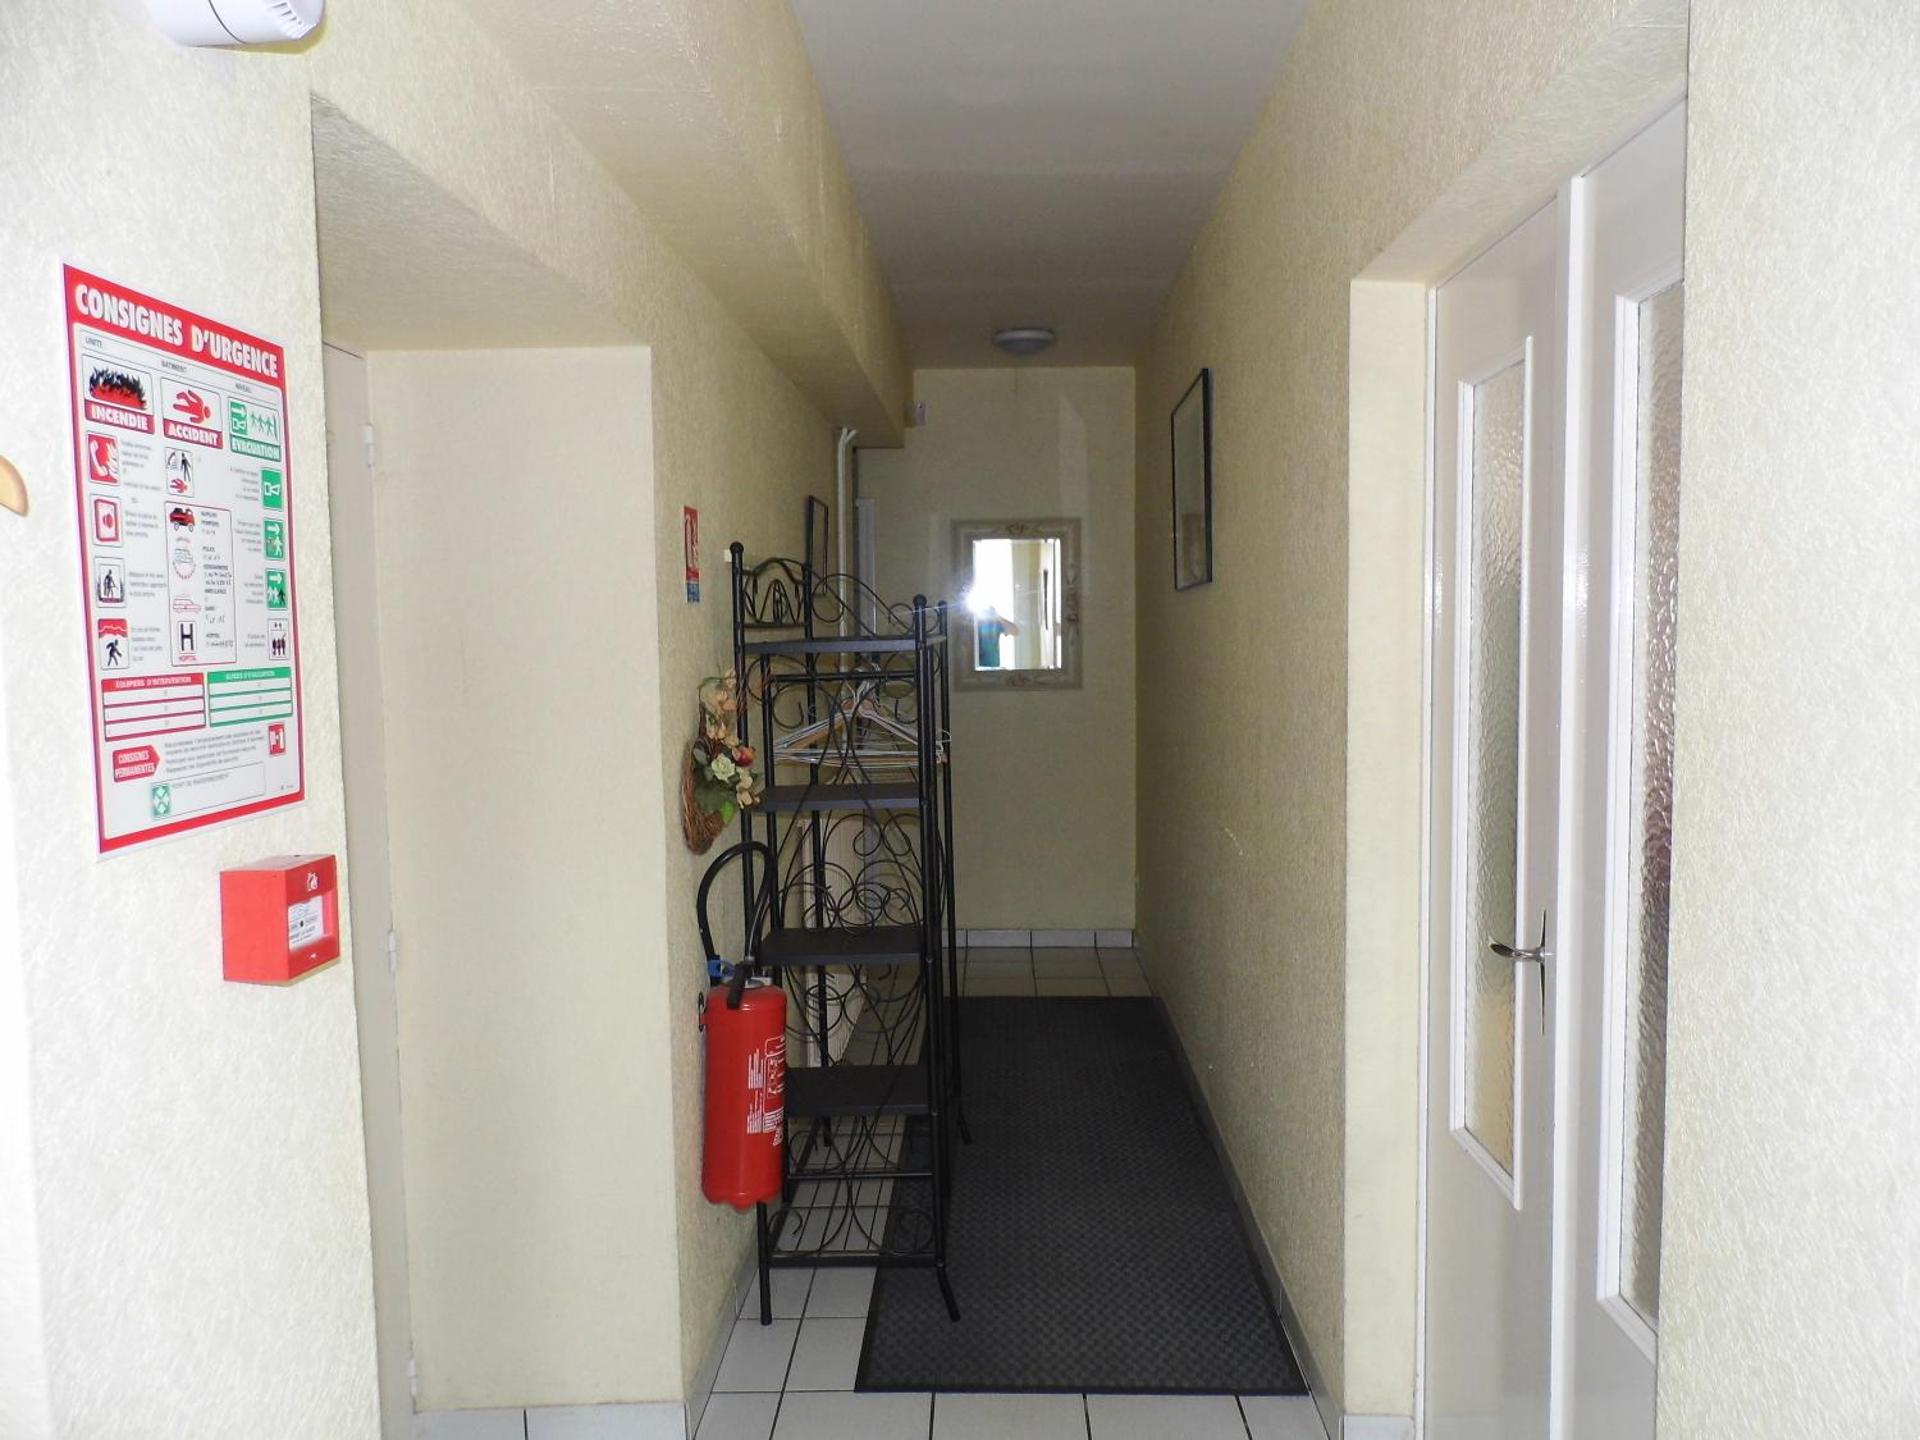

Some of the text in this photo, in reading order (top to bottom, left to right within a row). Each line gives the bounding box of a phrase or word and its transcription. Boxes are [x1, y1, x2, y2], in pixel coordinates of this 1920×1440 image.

[75, 284, 279, 379] CONSIGNES D'URGENCE
[91, 403, 149, 430] INCENDIE
[168, 422, 219, 446] ACCIDENT
